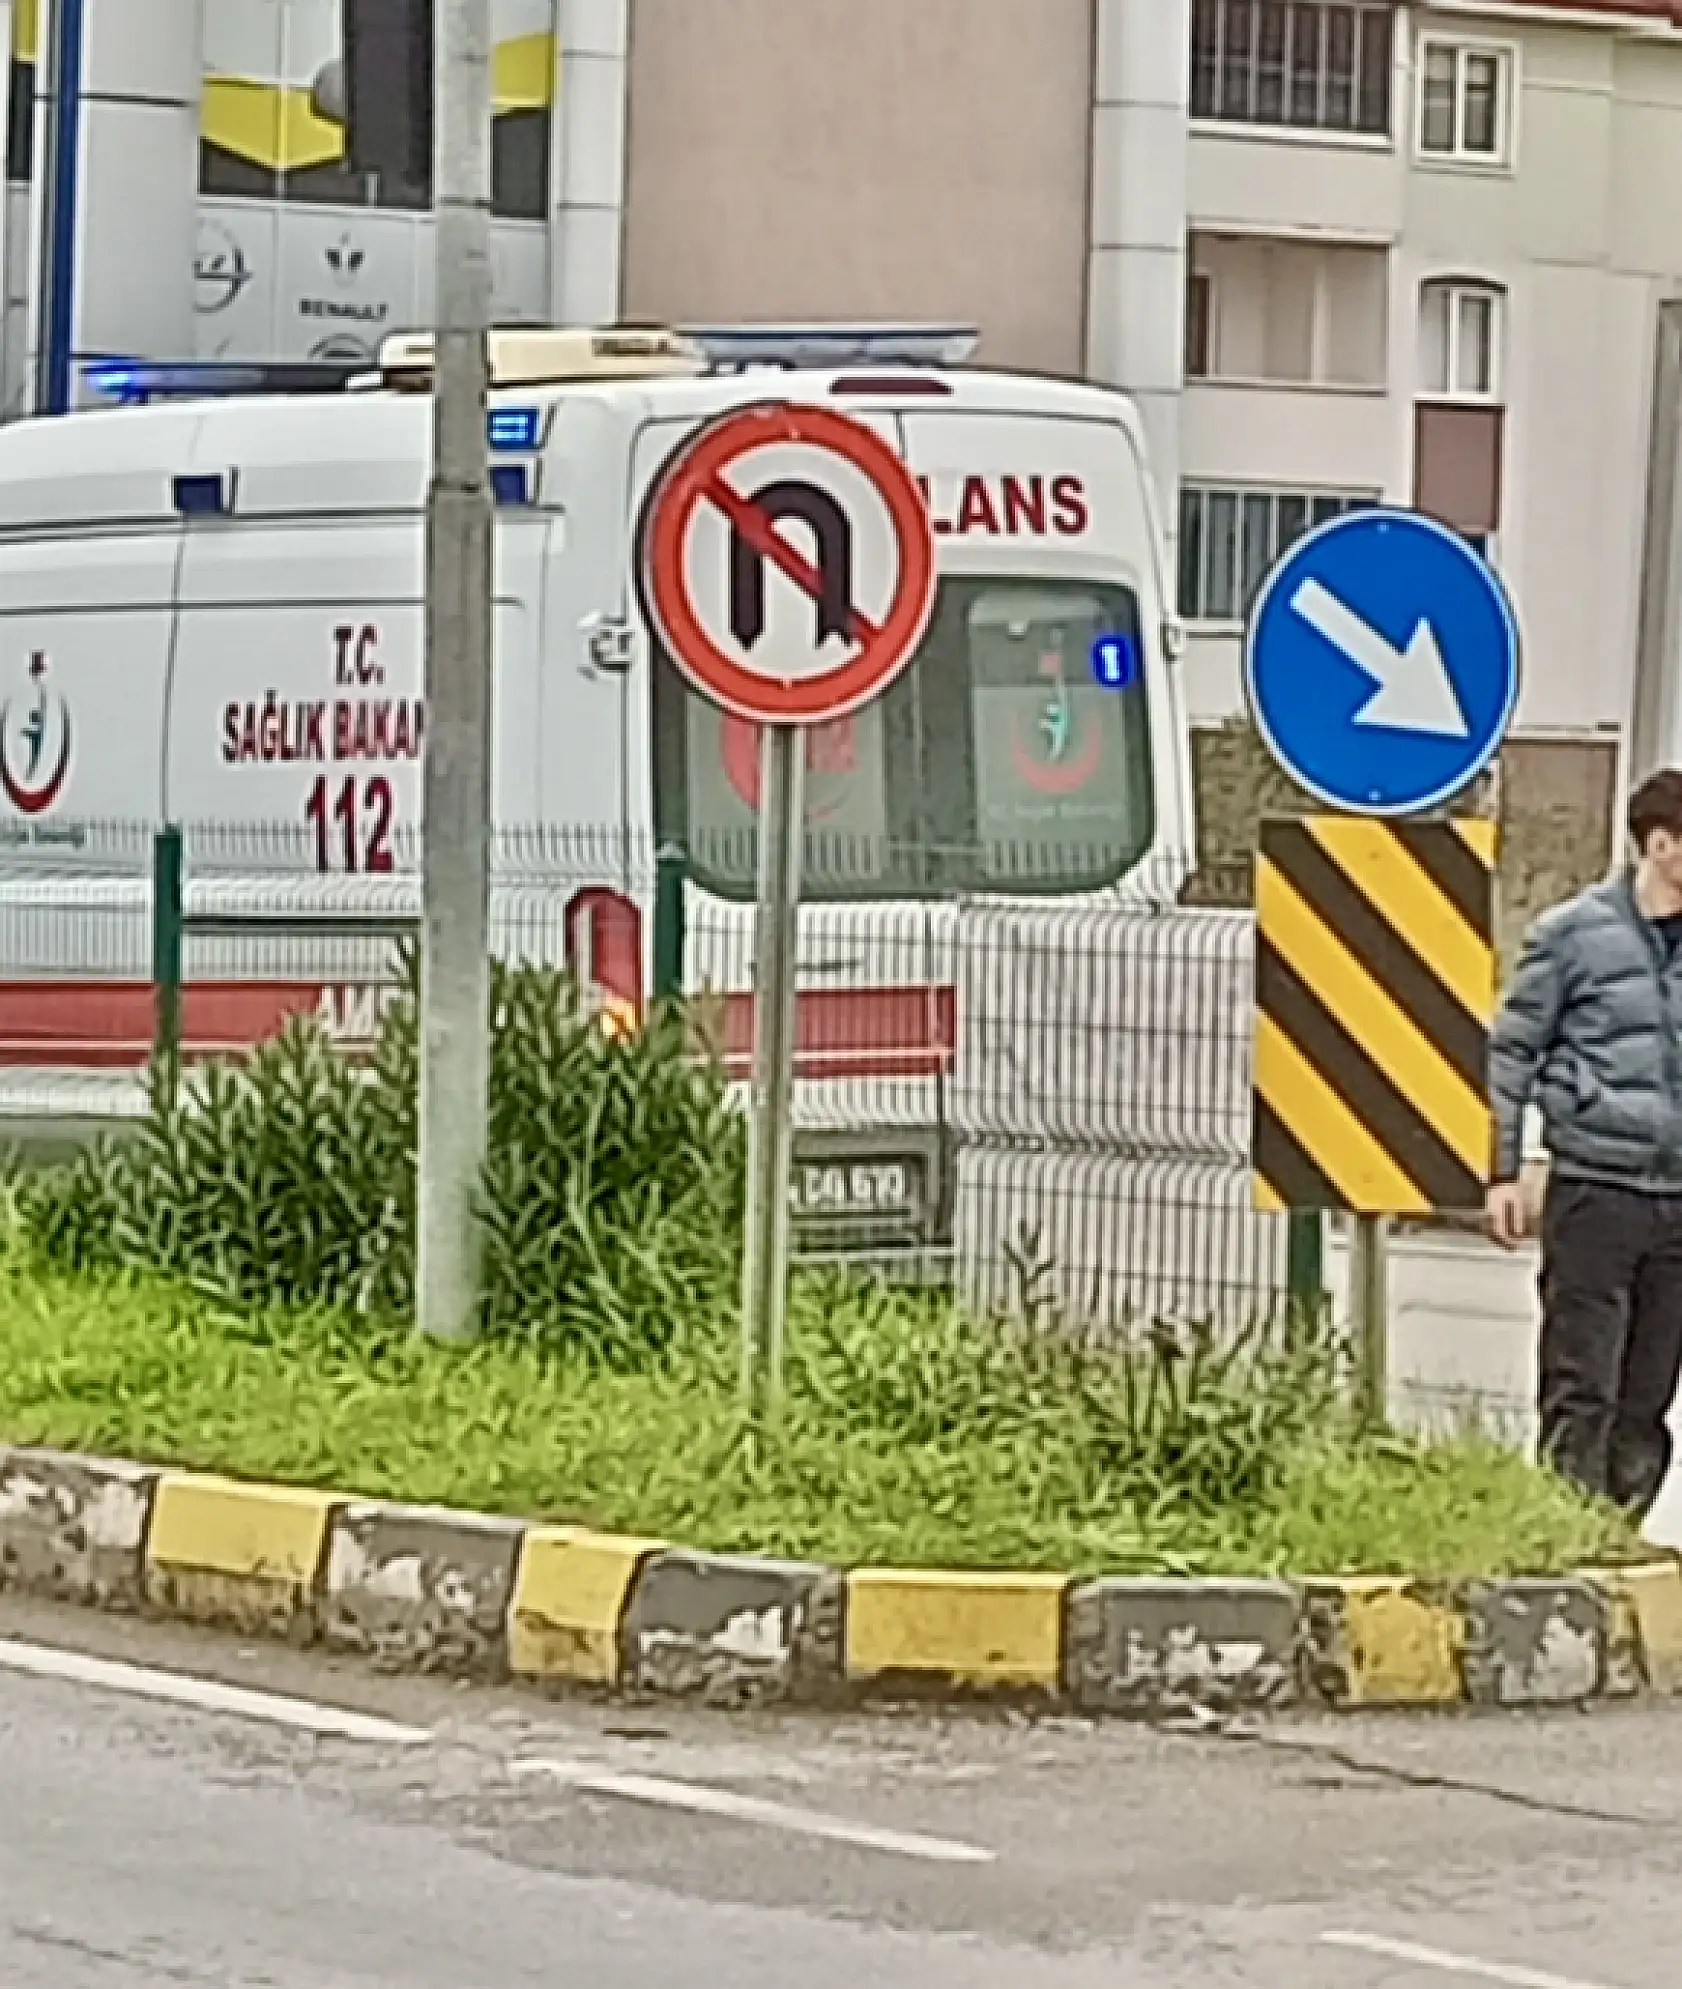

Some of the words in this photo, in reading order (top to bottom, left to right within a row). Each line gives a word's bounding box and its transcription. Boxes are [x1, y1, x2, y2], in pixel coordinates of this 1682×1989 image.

[333, 624, 387, 684] T.C.
[222, 688, 325, 761] SAĞLIK
[304, 774, 394, 873] 112
